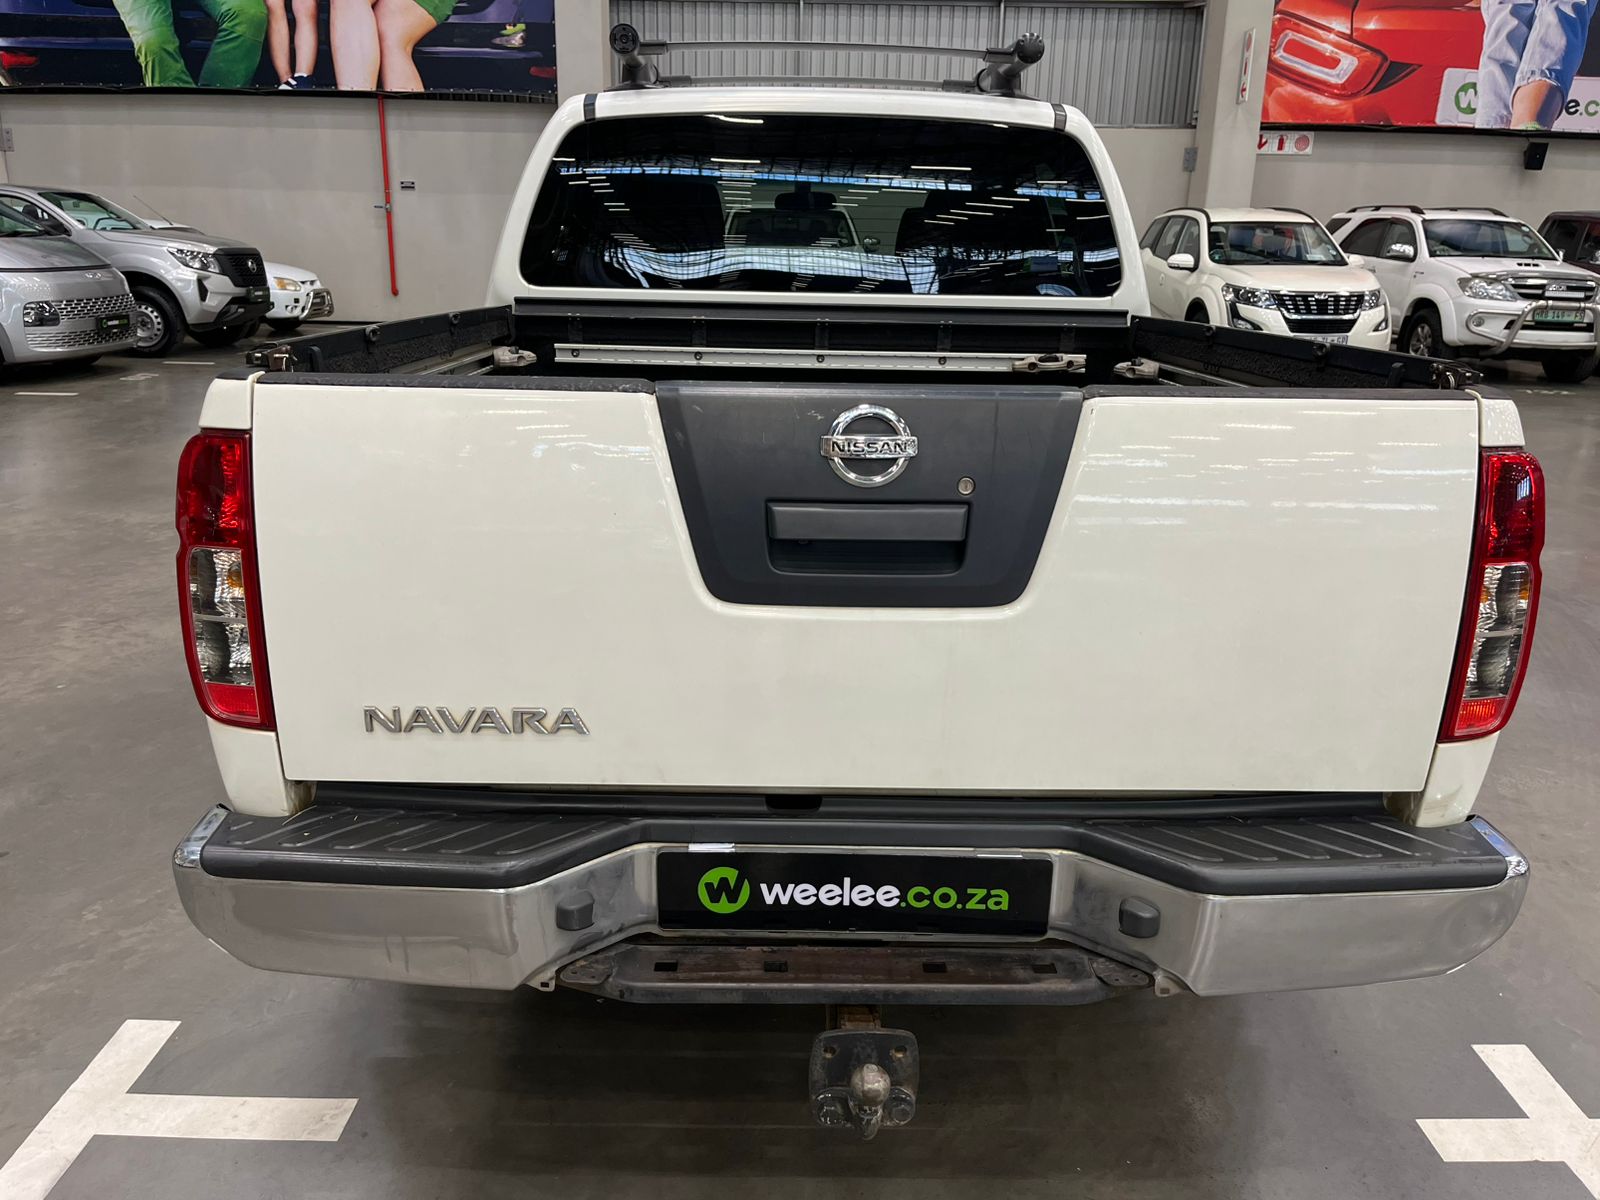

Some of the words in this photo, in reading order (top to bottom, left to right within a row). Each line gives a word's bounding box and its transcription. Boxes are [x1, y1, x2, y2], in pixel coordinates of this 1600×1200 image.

[831, 441, 908, 454] NISSAN
[363, 706, 590, 735] NAVARA
[759, 877, 1009, 911] weelee.co.za
